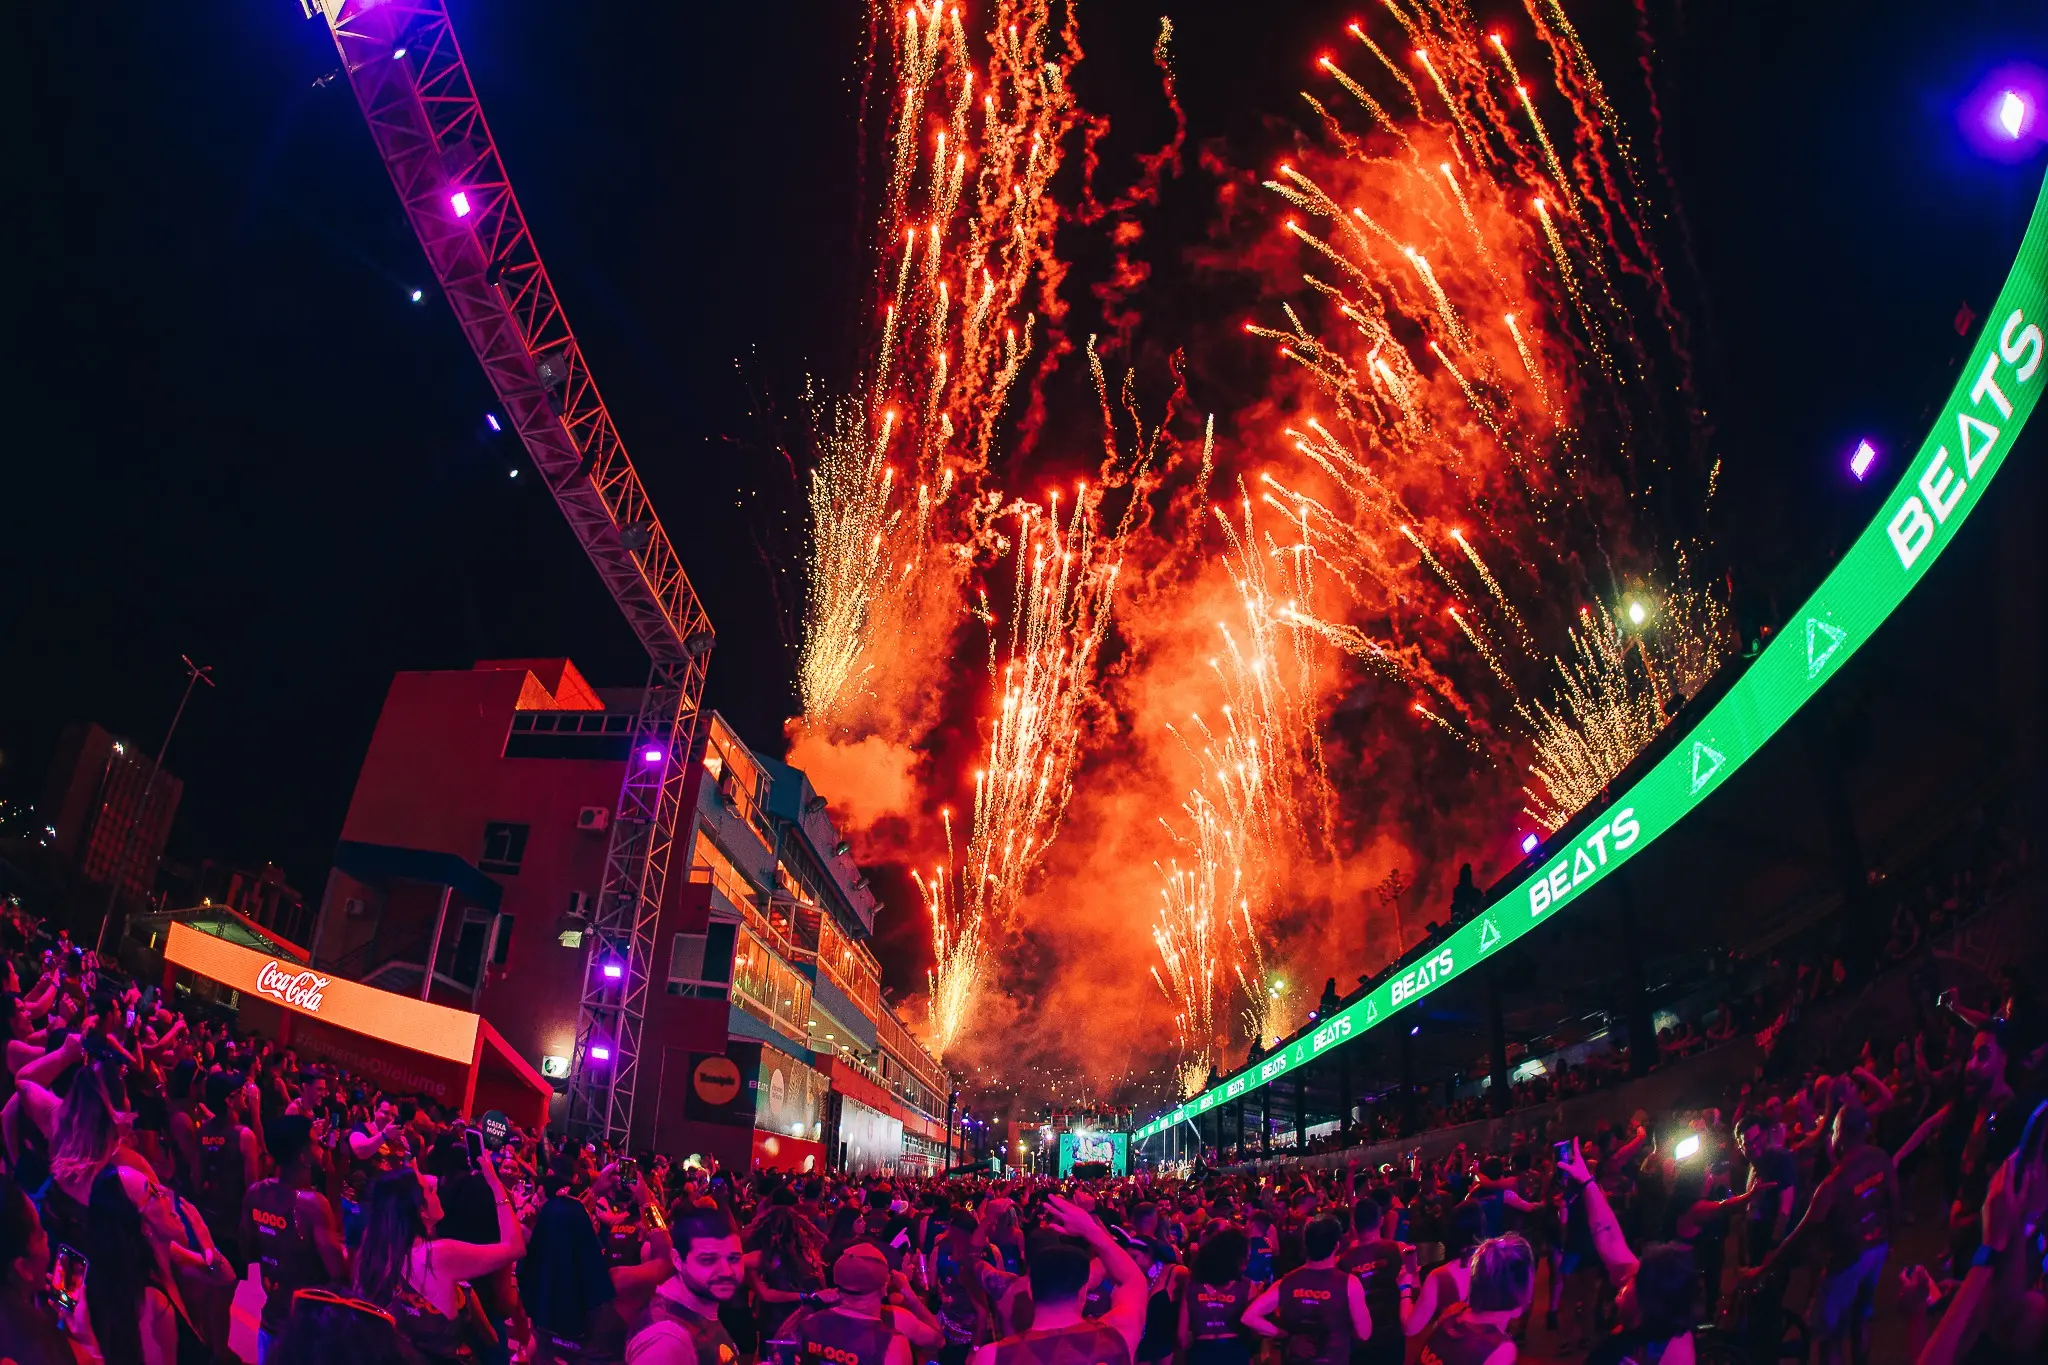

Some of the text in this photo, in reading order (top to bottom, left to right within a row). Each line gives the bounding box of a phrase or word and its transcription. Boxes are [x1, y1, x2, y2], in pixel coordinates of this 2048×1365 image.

[1886, 308, 2044, 571] BEATS
[1529, 807, 1640, 917] BEATS
[257, 960, 332, 1012] Coca-Cola
[1391, 948, 1453, 1006] BEATS
[1313, 1016, 1351, 1052] BEATS
[1261, 1054, 1286, 1080] BEATS
[1227, 1078, 1245, 1097] BEATS
[487, 1119, 506, 1131] CAIXA
[252, 1208, 287, 1230] BLOCO
[1293, 1288, 1331, 1300] BLOCO
